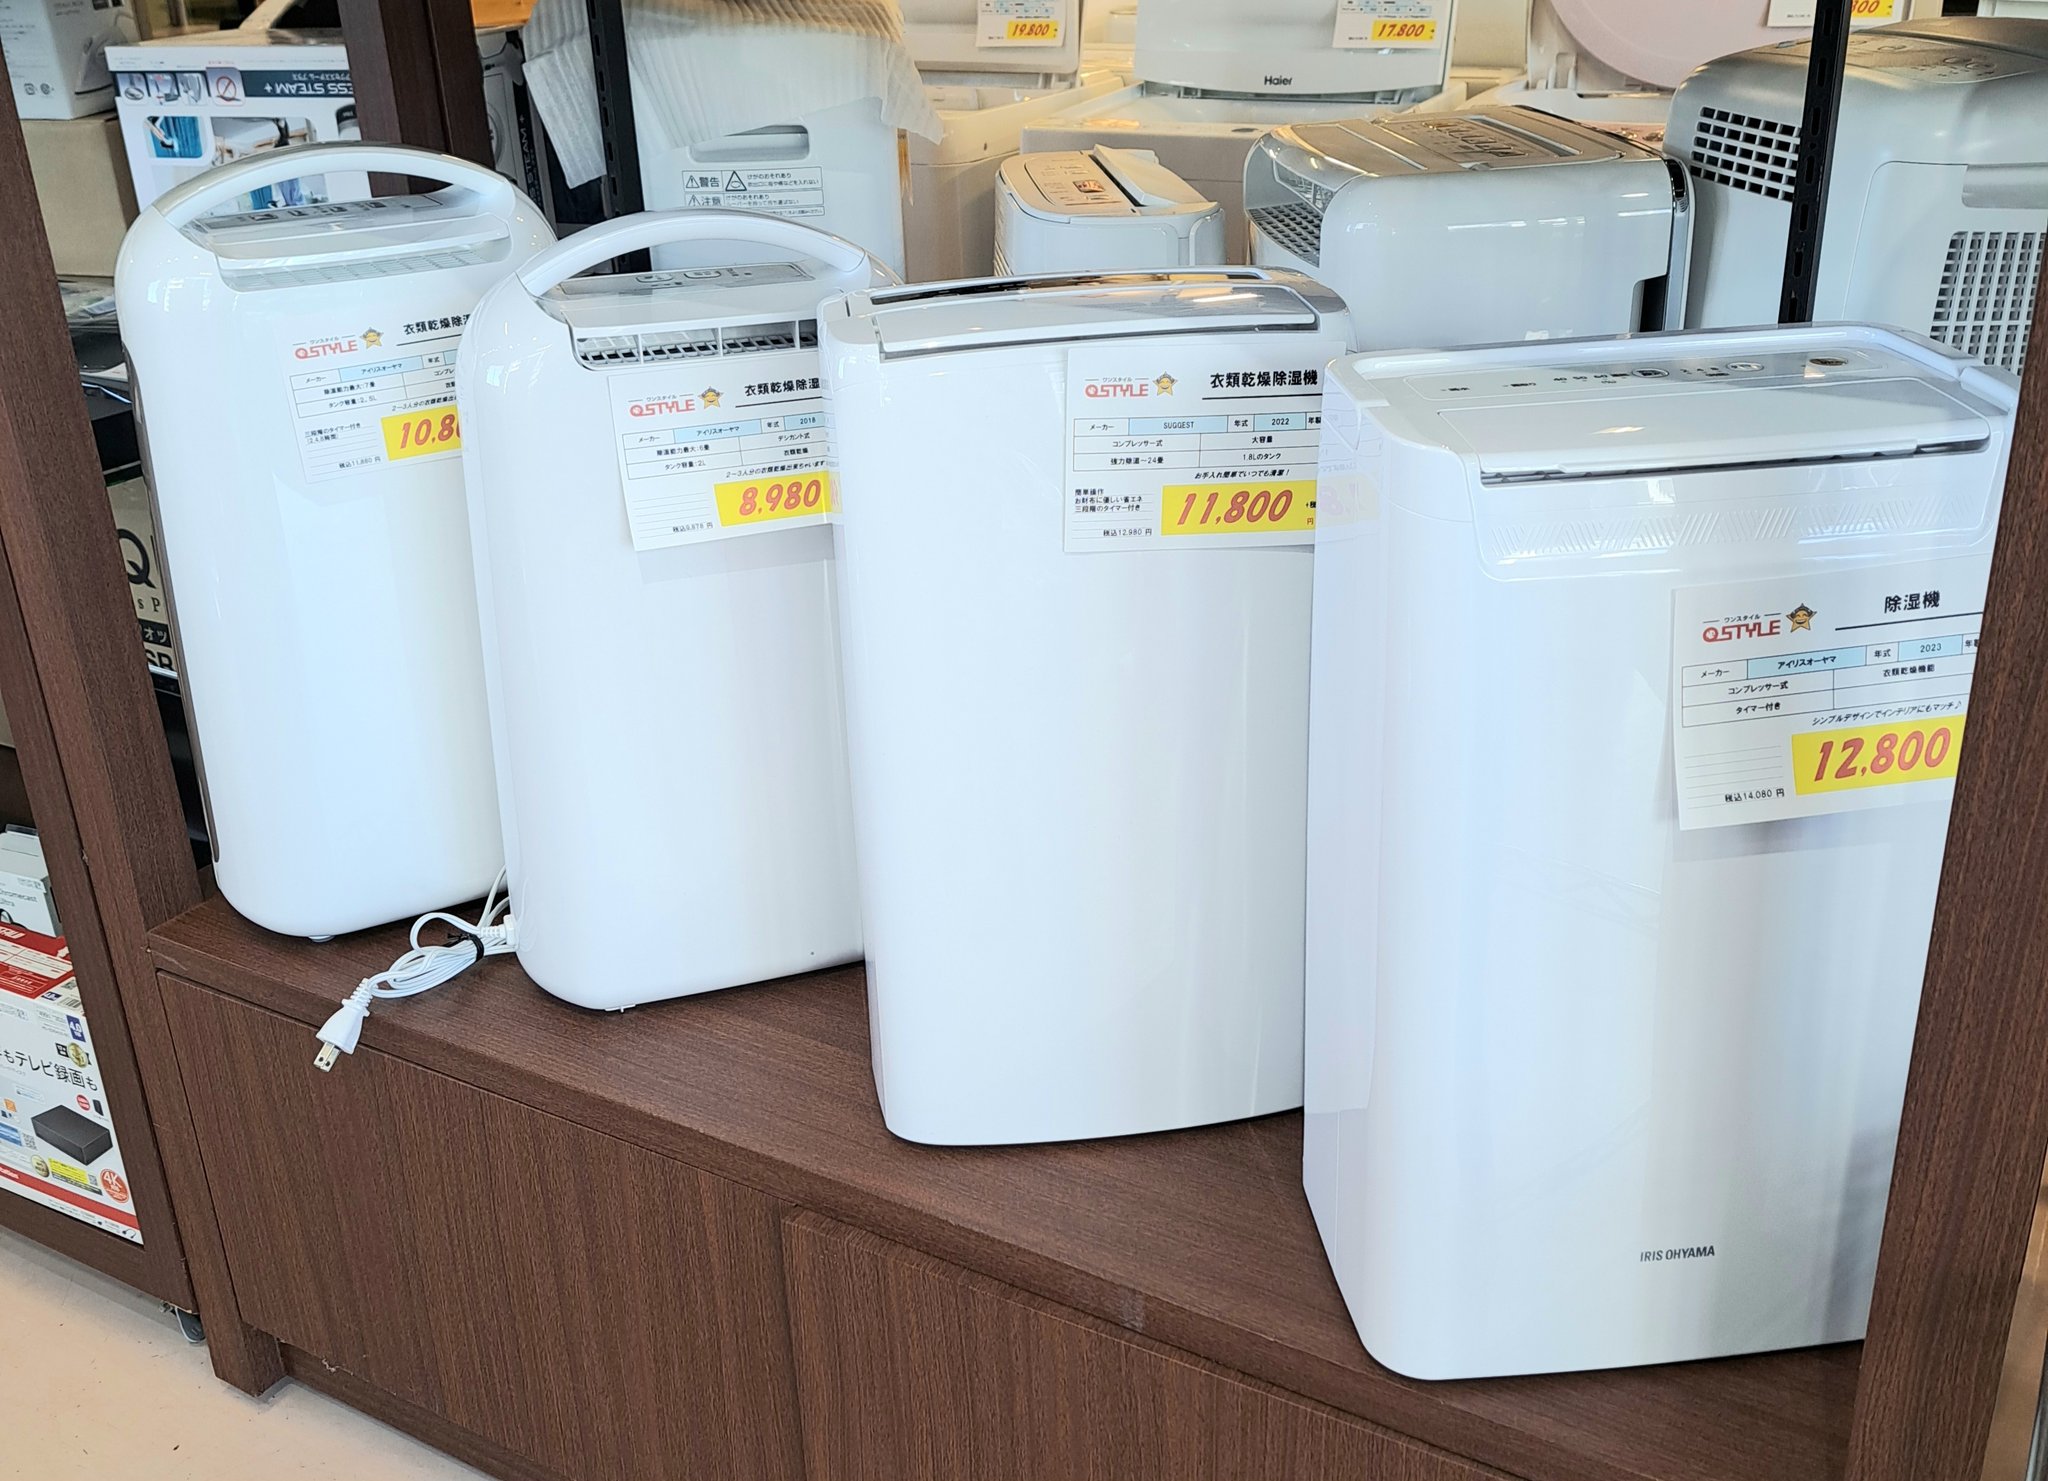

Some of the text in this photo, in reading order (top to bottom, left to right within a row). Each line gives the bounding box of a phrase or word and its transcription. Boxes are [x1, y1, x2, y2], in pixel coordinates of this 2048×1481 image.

[1264, 75, 1292, 86] Haier
[276, 82, 325, 94] STEAM
[699, 176, 720, 188] 警告
[295, 340, 358, 360] QSTYLE
[361, 364, 402, 374] アイリスオーヤマ
[305, 376, 327, 384] メーカー
[1210, 370, 1318, 388] 衣類乾燥除湿機
[1085, 384, 1148, 398] QSTYLE
[630, 400, 695, 417] QSTYLE
[800, 416, 816, 424] 2018
[1234, 420, 1248, 428] 年式
[1271, 418, 1290, 426] 2022
[696, 426, 740, 436] アイリスオーヤマ
[1112, 440, 1163, 448] コンプレッサー式
[1252, 436, 1272, 444] 大容量
[1177, 490, 1293, 526] 11,800
[1306, 518, 1314, 526] 円
[1884, 590, 1941, 614] 除湿機
[1724, 614, 1760, 623] ワンスタイル
[1703, 620, 1781, 643] QSTYLE
[1874, 648, 1892, 658] 年式
[1920, 642, 1942, 653] 2023
[1777, 656, 1837, 670] アイリスオーヤマ
[1700, 668, 1730, 679] メーカー
[1882, 664, 1936, 678] 衣類乾燥機能
[1728, 681, 1788, 696] コンプレッサー式
[1736, 702, 1781, 715] タイマー付き
[1814, 728, 1951, 782] 12,800
[1776, 788, 1784, 798] 円
[0, 1048, 98, 1092] もテレビ録画も
[1640, 1245, 1715, 1262] IRIS OHYAMA
